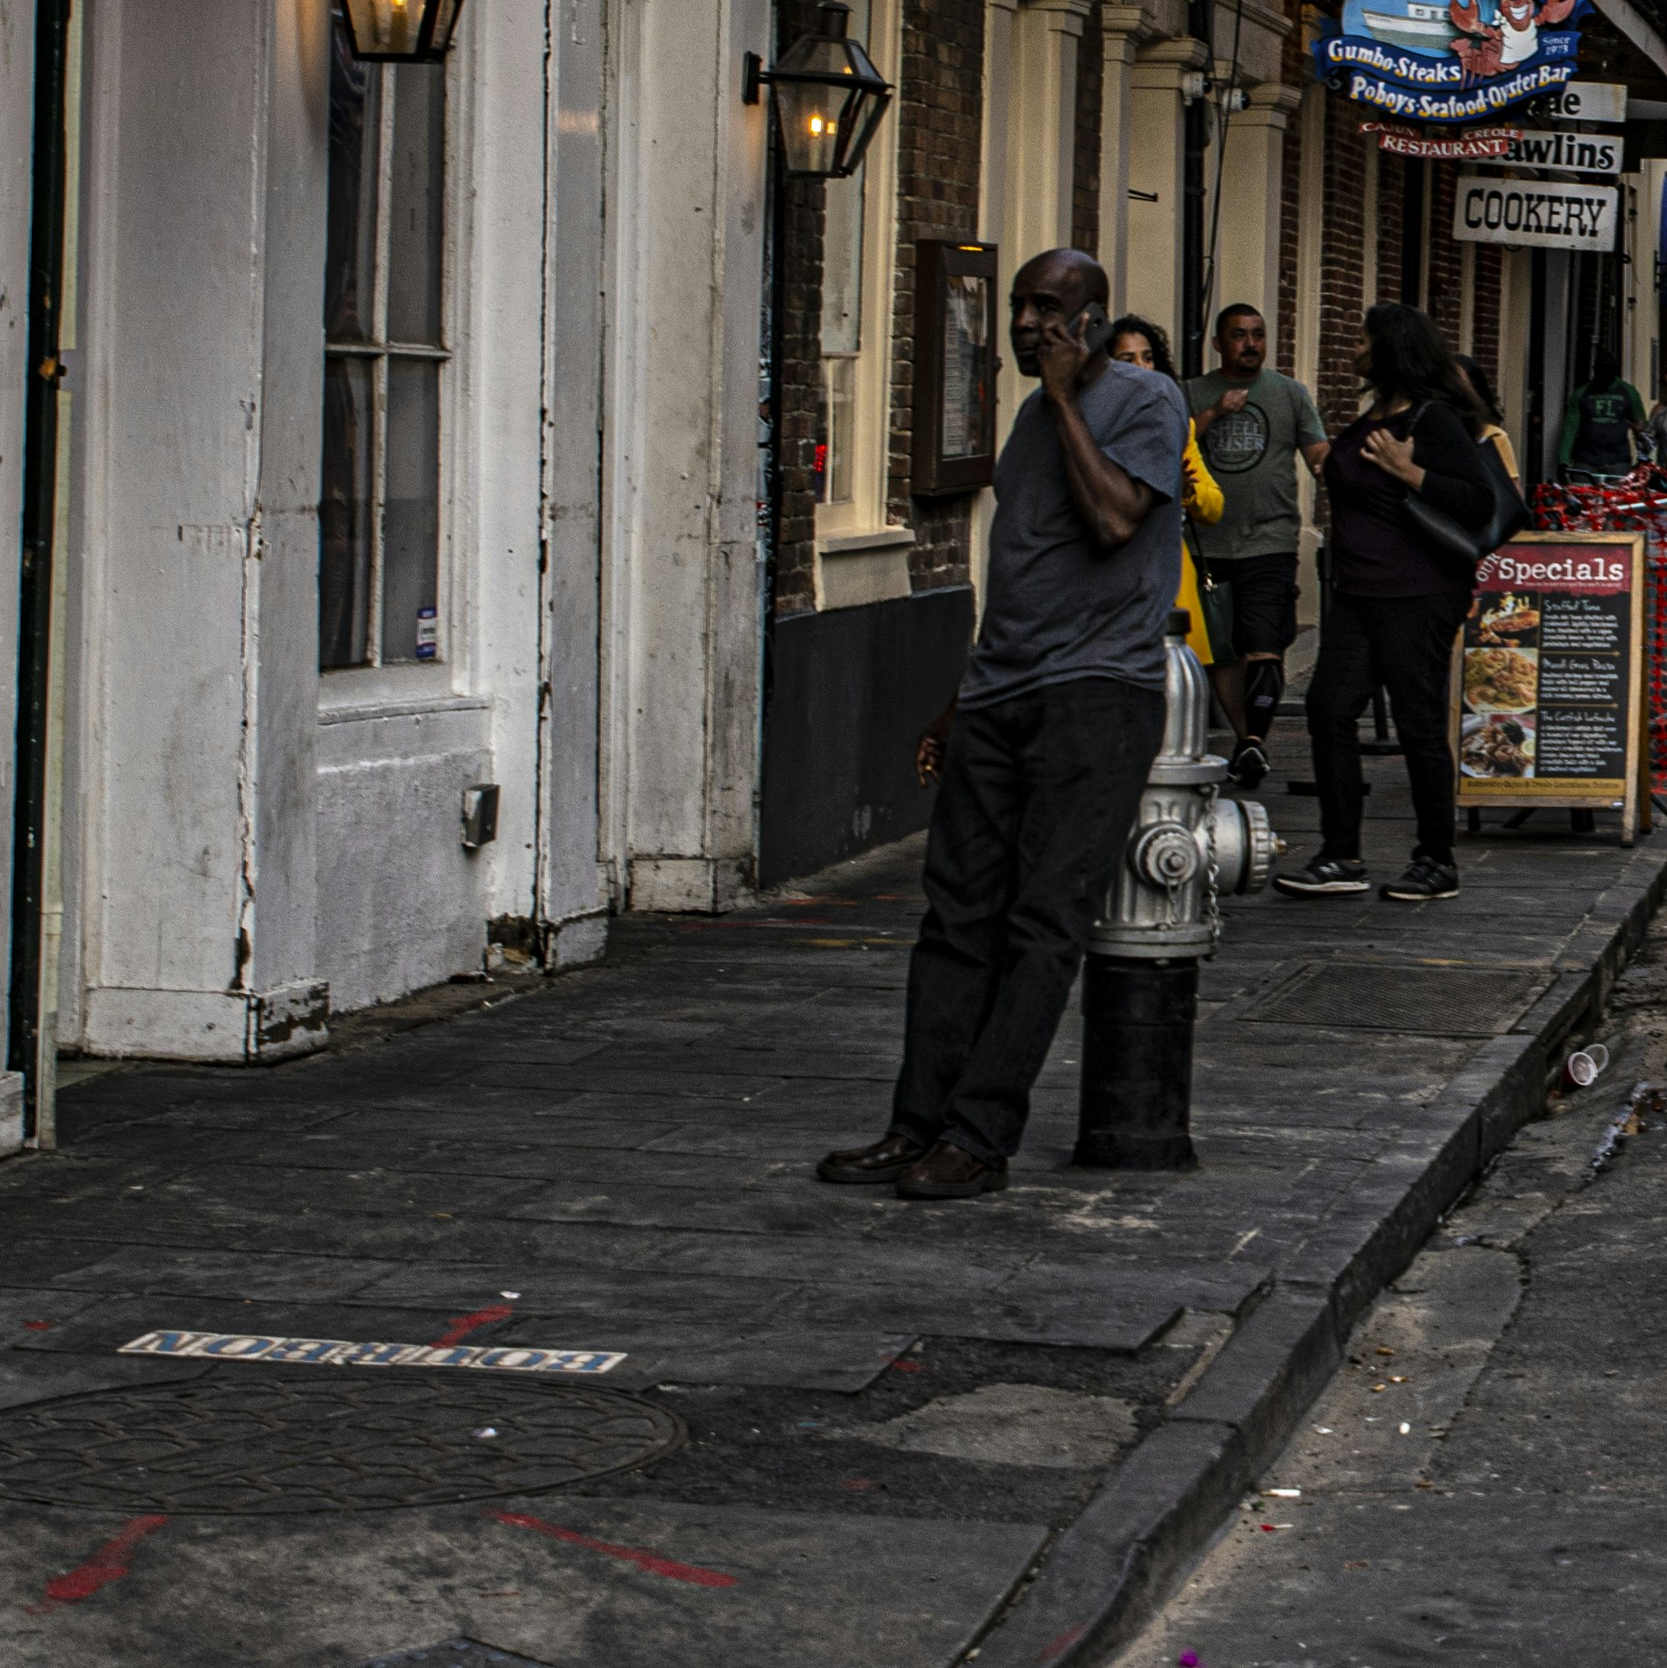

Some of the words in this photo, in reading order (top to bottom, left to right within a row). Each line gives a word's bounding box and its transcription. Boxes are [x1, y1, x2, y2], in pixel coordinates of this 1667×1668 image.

[1383, 136, 1504, 156] RESTAURANT
[1503, 134, 1615, 170] awlins
[1465, 188, 1607, 237] COOKERY
[1476, 553, 1502, 582] OUR
[1500, 558, 1624, 585] Specials
[125, 1332, 611, 1372] BOURBON
